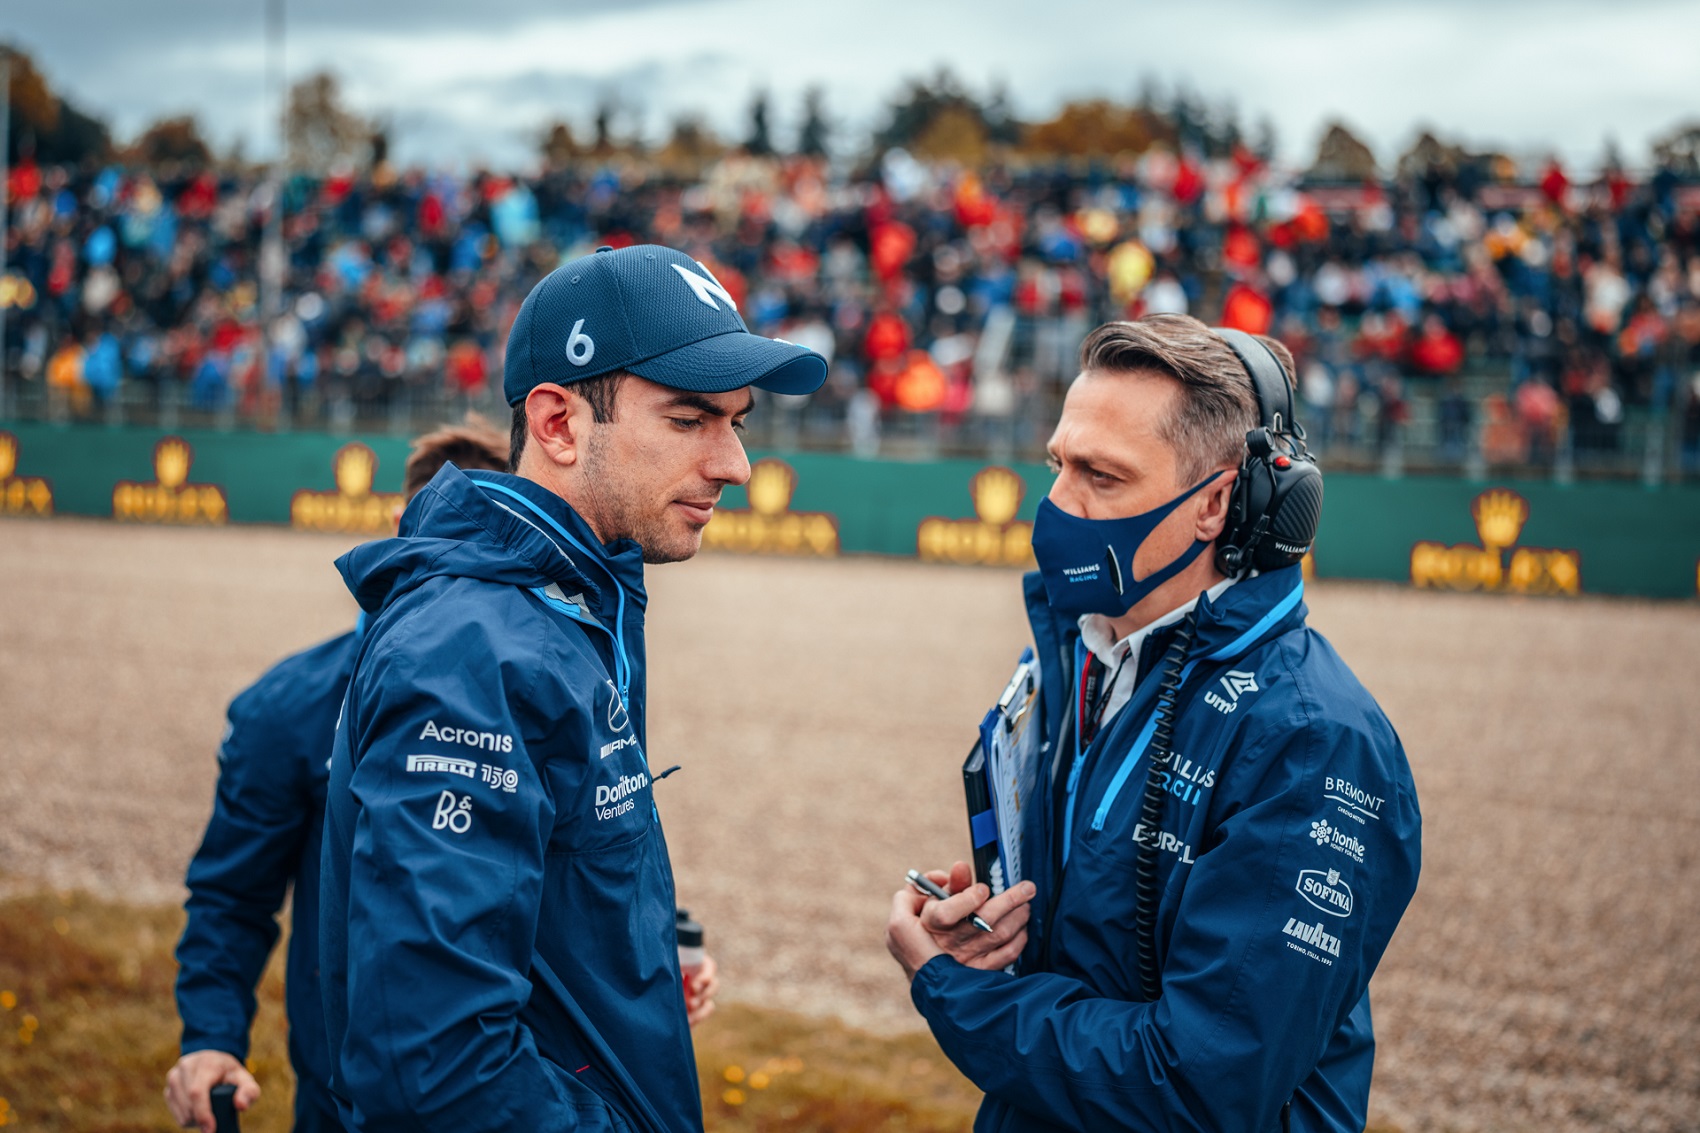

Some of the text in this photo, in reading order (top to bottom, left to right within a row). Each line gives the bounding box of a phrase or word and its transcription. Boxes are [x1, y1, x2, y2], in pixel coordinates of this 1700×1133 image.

[565, 318, 595, 367] 6
[1062, 563, 1100, 576] WILLIAMS
[1069, 573, 1098, 583] RACING
[419, 720, 513, 753] Acronis
[406, 754, 518, 789] PIRELLI 150
[595, 798, 634, 821] Ventures
[1325, 777, 1385, 811] BREMONT
[1303, 878, 1349, 912] SOFINA
[1282, 917, 1341, 958] LAVAZZA
